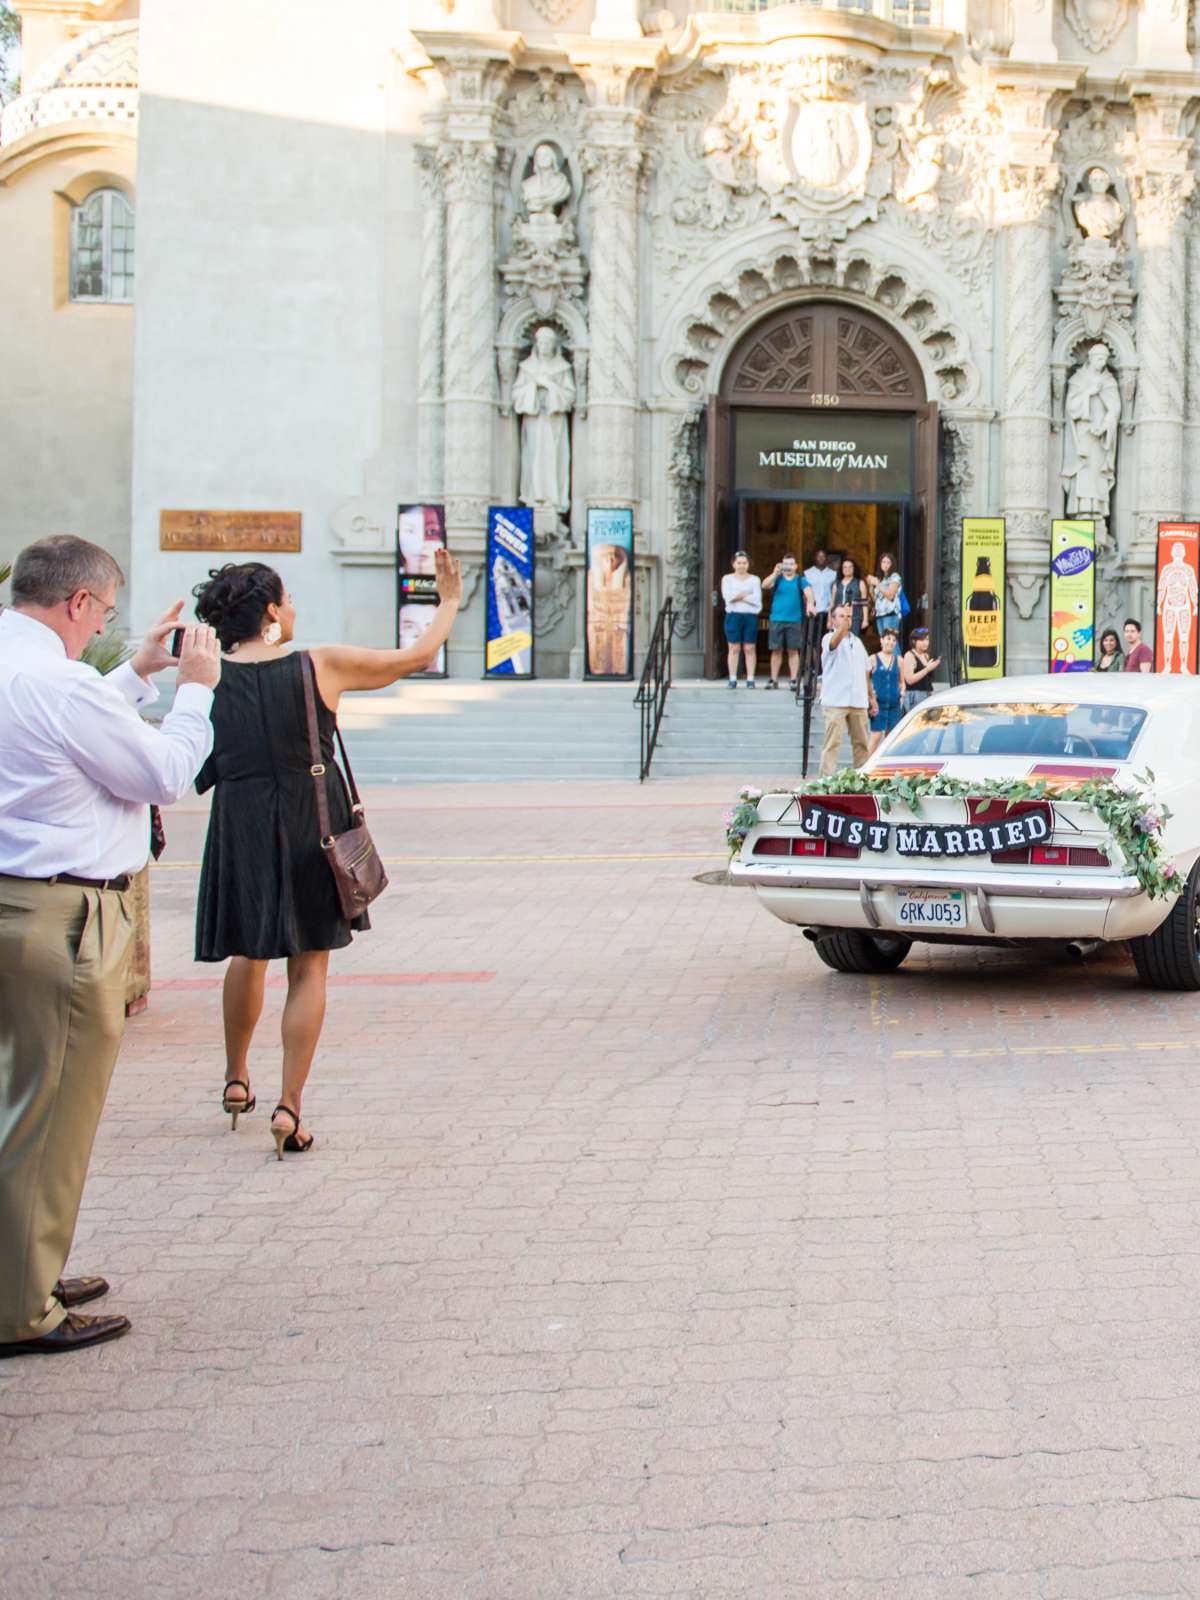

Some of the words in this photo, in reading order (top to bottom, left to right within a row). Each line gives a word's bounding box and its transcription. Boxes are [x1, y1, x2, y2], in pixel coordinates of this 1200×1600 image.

[811, 393, 840, 406] 1350
[793, 440, 816, 450] SAN
[819, 441, 856, 451] DIEGO
[759, 452, 831, 467] MUSEUM
[832, 454, 847, 472] of
[848, 454, 888, 469] MAN
[969, 615, 997, 624] BEER
[804, 808, 887, 850] JUST
[898, 815, 1047, 854] MARRIED
[908, 888, 948, 902] California
[900, 902, 961, 922] 6RKJ053
